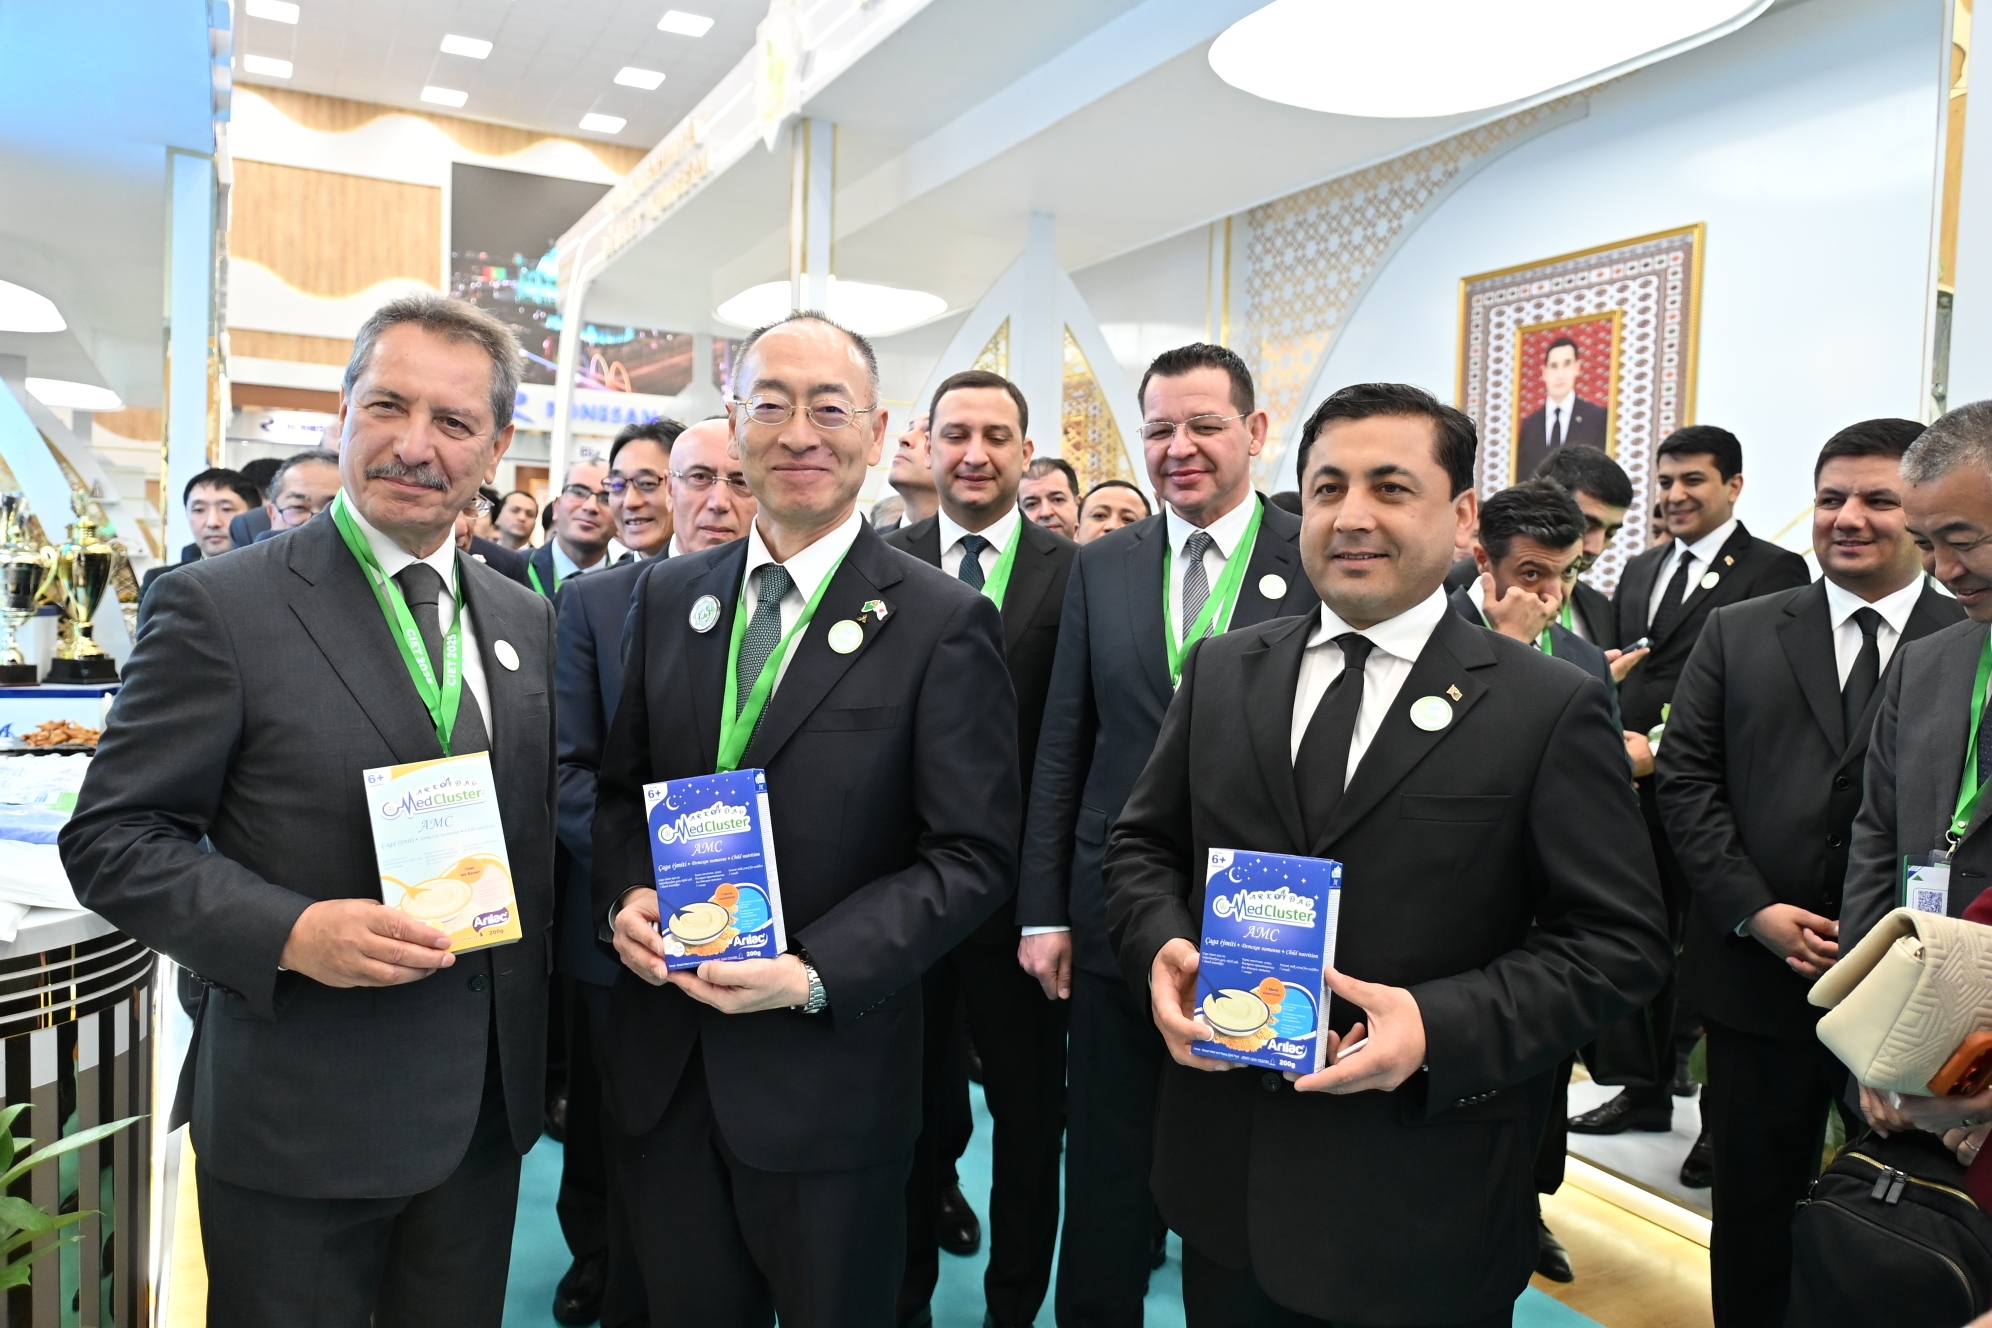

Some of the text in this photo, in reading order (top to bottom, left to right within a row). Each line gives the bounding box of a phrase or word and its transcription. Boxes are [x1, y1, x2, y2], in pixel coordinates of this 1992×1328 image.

[406, 628, 423, 655] CIET
[446, 633, 458, 687] CIET 2025
[367, 773, 385, 785] 6+
[401, 790, 483, 815] MedCluster
[647, 789, 662, 799] 6+
[418, 815, 454, 833] AMC
[677, 815, 749, 841] MedCluster
[691, 840, 723, 857] AMC
[1211, 854, 1227, 864] 6+
[1234, 891, 1314, 922] MedCluster
[1243, 925, 1281, 942] AMC
[1279, 1059, 1296, 1070] 200g
